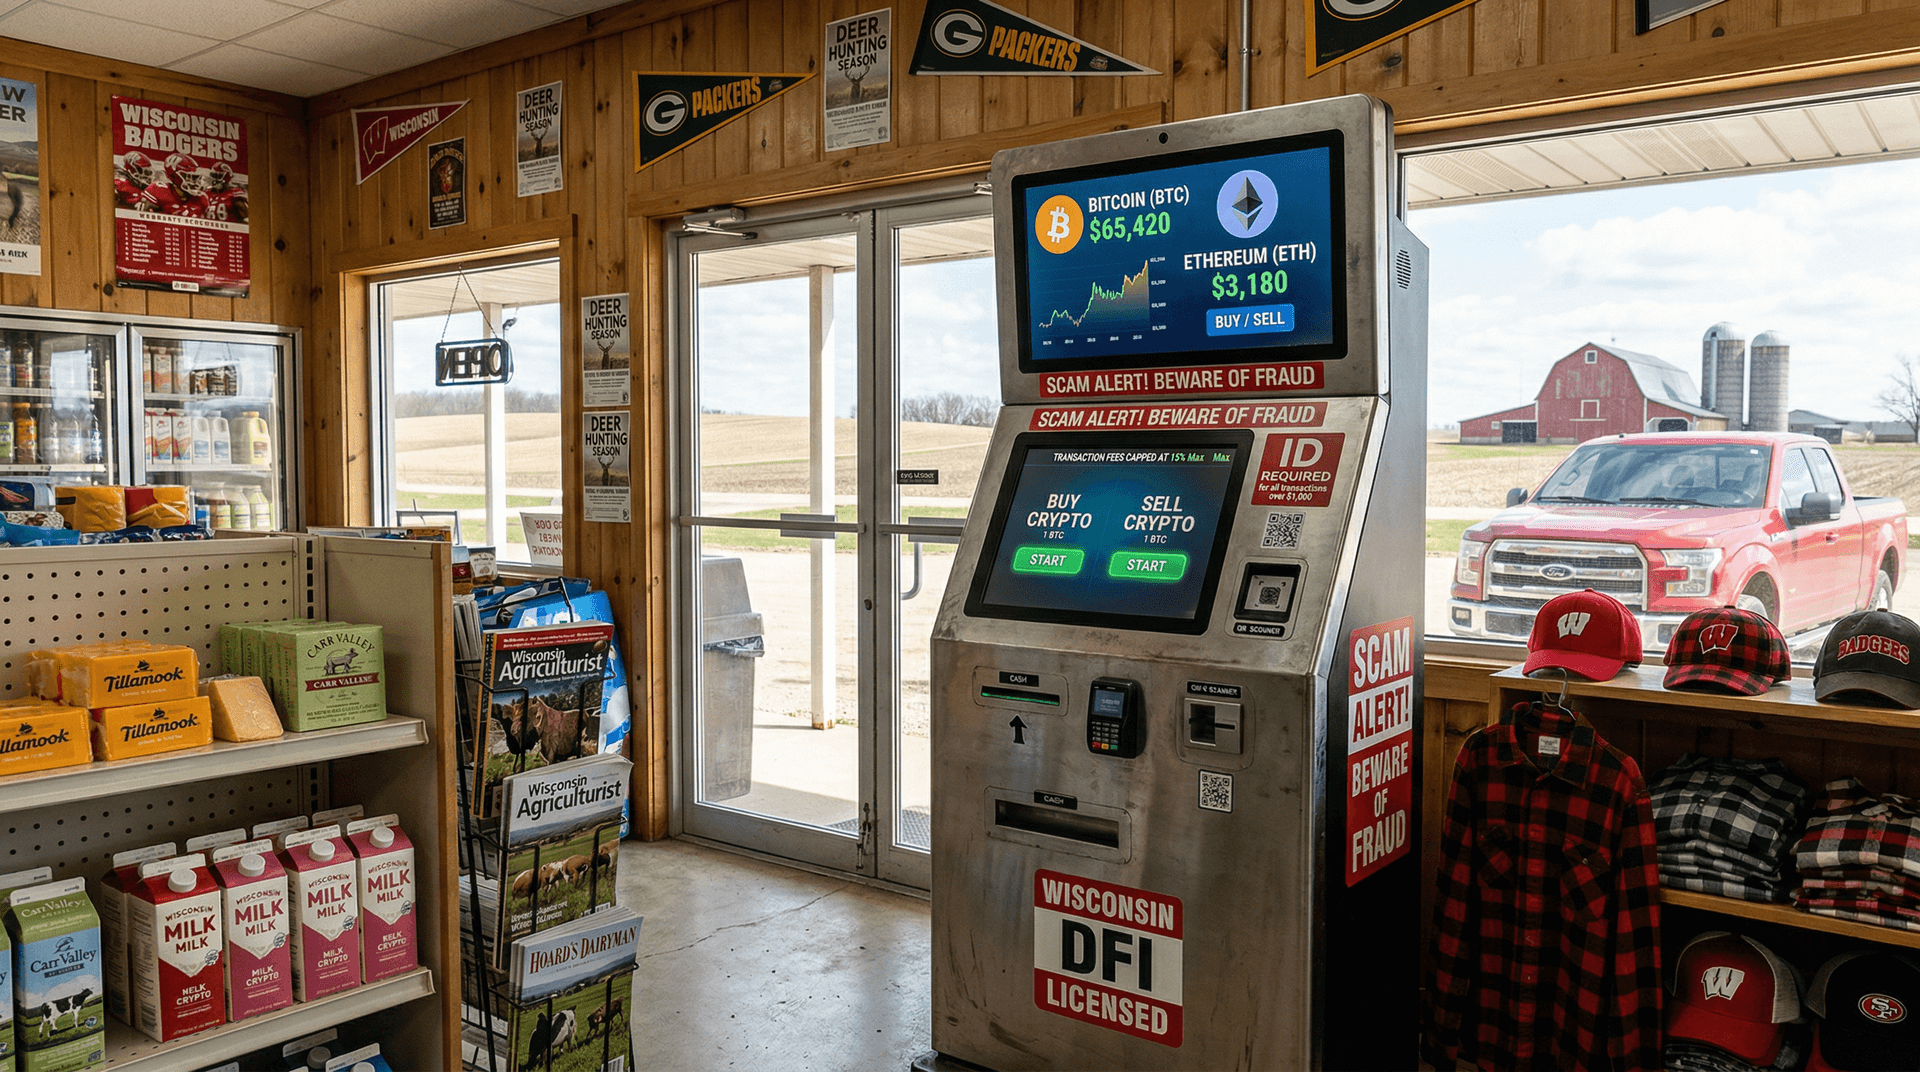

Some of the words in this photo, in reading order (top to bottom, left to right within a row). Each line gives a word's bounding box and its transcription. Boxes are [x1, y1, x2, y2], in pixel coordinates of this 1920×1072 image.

[836, 16, 880, 44] DEER
[828, 34, 888, 62] HUNTING
[988, 25, 1082, 72] PACKERS
[838, 52, 878, 72] SEASON
[525, 88, 554, 109] DEER
[692, 76, 762, 118] PACKERS
[119, 102, 240, 141] WISCONSIN
[520, 102, 559, 124] HUNTING
[389, 108, 440, 142] WISCONSIN
[525, 117, 552, 132] SEASON
[124, 124, 238, 162] BADGERS
[1088, 191, 1146, 214] BITCOIN
[1150, 185, 1190, 210] (BTC)
[1090, 210, 1172, 244] $65,420
[1183, 247, 1268, 271] ETHEREUM
[1272, 242, 1318, 266] (ETH)
[1212, 269, 1289, 302] $3,180
[590, 298, 622, 316] DEER
[585, 314, 627, 331] HUNTING
[1215, 314, 1241, 330] BUY
[1252, 310, 1286, 328] SELL
[591, 329, 621, 340] SEASON
[1046, 376, 1091, 395] SCAM
[1094, 373, 1150, 393] ALERT!
[1154, 370, 1225, 391] BEWARE
[1228, 368, 1252, 388] OF
[1254, 366, 1316, 388] FRAUD
[591, 416, 622, 432] DEER
[1037, 410, 1083, 428] SCAM
[1085, 409, 1144, 427] ALERT!
[1147, 407, 1220, 426] BEWARE
[1224, 406, 1248, 424] OF
[1251, 405, 1316, 424] FRAUD
[586, 432, 628, 446] HUNTING
[592, 446, 621, 457] SEASON
[1053, 453, 1106, 462] TRANSACTION
[1106, 453, 1125, 462] FEES
[1126, 453, 1157, 462] CAPPED
[1158, 453, 1170, 462] AT
[1171, 453, 1186, 462] 15%
[1187, 453, 1204, 462] Max
[1212, 453, 1231, 462] Max
[1279, 438, 1324, 468] ID
[1260, 471, 1332, 483] REQUIRED
[1270, 483, 1280, 492] all
[1046, 494, 1082, 510] BUY
[1141, 496, 1184, 512] SELL
[1269, 493, 1286, 501] over
[1286, 492, 1313, 502] $1,000
[1026, 512, 1093, 530] CRYPTO
[1124, 514, 1196, 533] CRYPTO
[1050, 531, 1066, 540] BTC
[1150, 535, 1168, 544] BTC
[1029, 554, 1068, 568] START
[1126, 559, 1167, 572] START
[307, 636, 335, 659] CARR
[336, 633, 375, 653] VALLEY
[511, 648, 566, 664] Wisconsin
[1838, 635, 1910, 665] BADGERS
[1353, 627, 1410, 689] SCAM
[104, 666, 184, 692] Tillamook
[499, 653, 603, 686] Agriculturist
[313, 680, 338, 689] CARR
[1352, 686, 1411, 745] ALERT!
[120, 714, 198, 742] Tillamook
[1351, 742, 1409, 798] BEWARE
[516, 781, 622, 821] Agriculturist
[1374, 794, 1388, 816] OF
[1352, 809, 1407, 874] FRAUD
[367, 869, 411, 894] MILK
[307, 882, 353, 908] MILK
[376, 888, 405, 904] MILK
[1042, 878, 1175, 932] WISCONSIN
[21, 904, 46, 918] Carr
[234, 898, 284, 926] MILK
[317, 903, 347, 919] MILK
[164, 914, 217, 943] MILK
[245, 919, 277, 937] MILK
[176, 936, 209, 954] MILK
[377, 938, 407, 952] CRYPTO
[529, 941, 579, 975] HOARD'S
[580, 926, 637, 960] DAIRYMAN
[1061, 919, 1154, 992] DFI
[30, 958, 59, 973] Carr
[59, 949, 98, 965] Valley
[252, 965, 274, 977] MILK
[318, 954, 348, 968] CRYPTO
[246, 972, 279, 987] CRYPTO
[176, 990, 212, 1006] CRYPTO
[1047, 977, 1168, 1037] LICENSED
